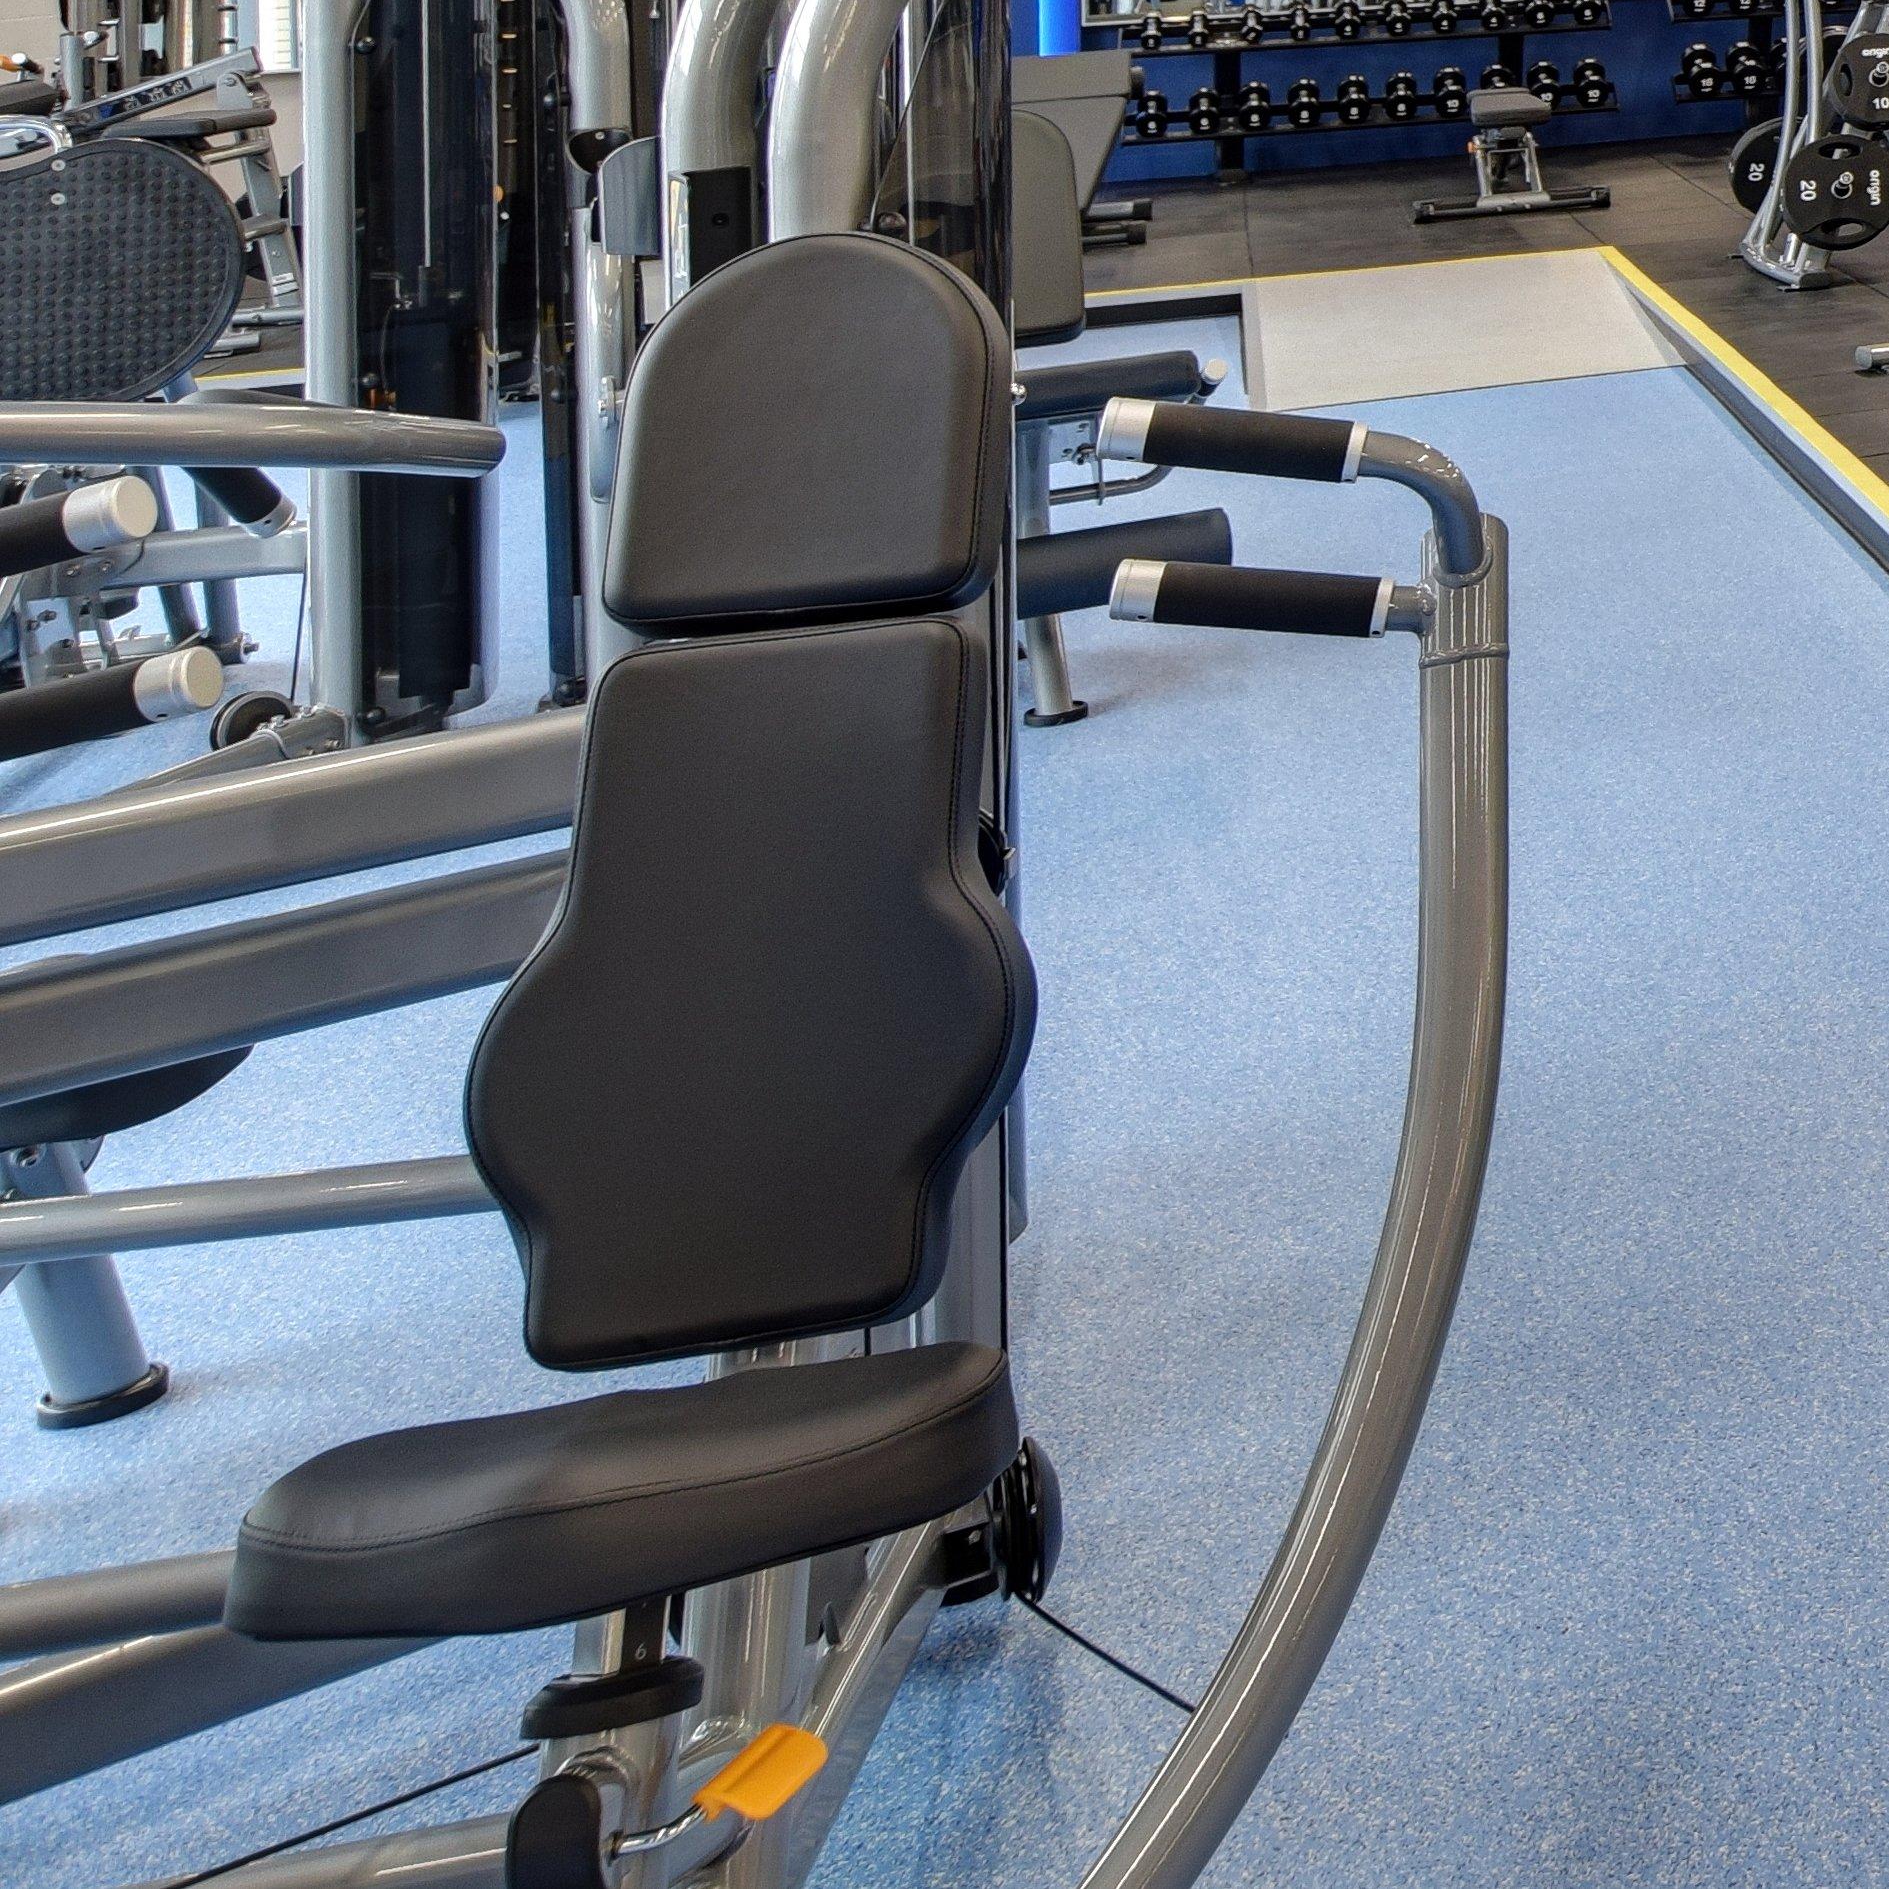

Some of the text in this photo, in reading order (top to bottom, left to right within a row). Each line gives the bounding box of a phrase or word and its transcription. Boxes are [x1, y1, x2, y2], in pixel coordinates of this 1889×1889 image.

[1748, 163, 1765, 182] 20
[1800, 179, 1817, 202] 20
[1866, 169, 1882, 206] origin
[635, 1641, 647, 1660] 6
